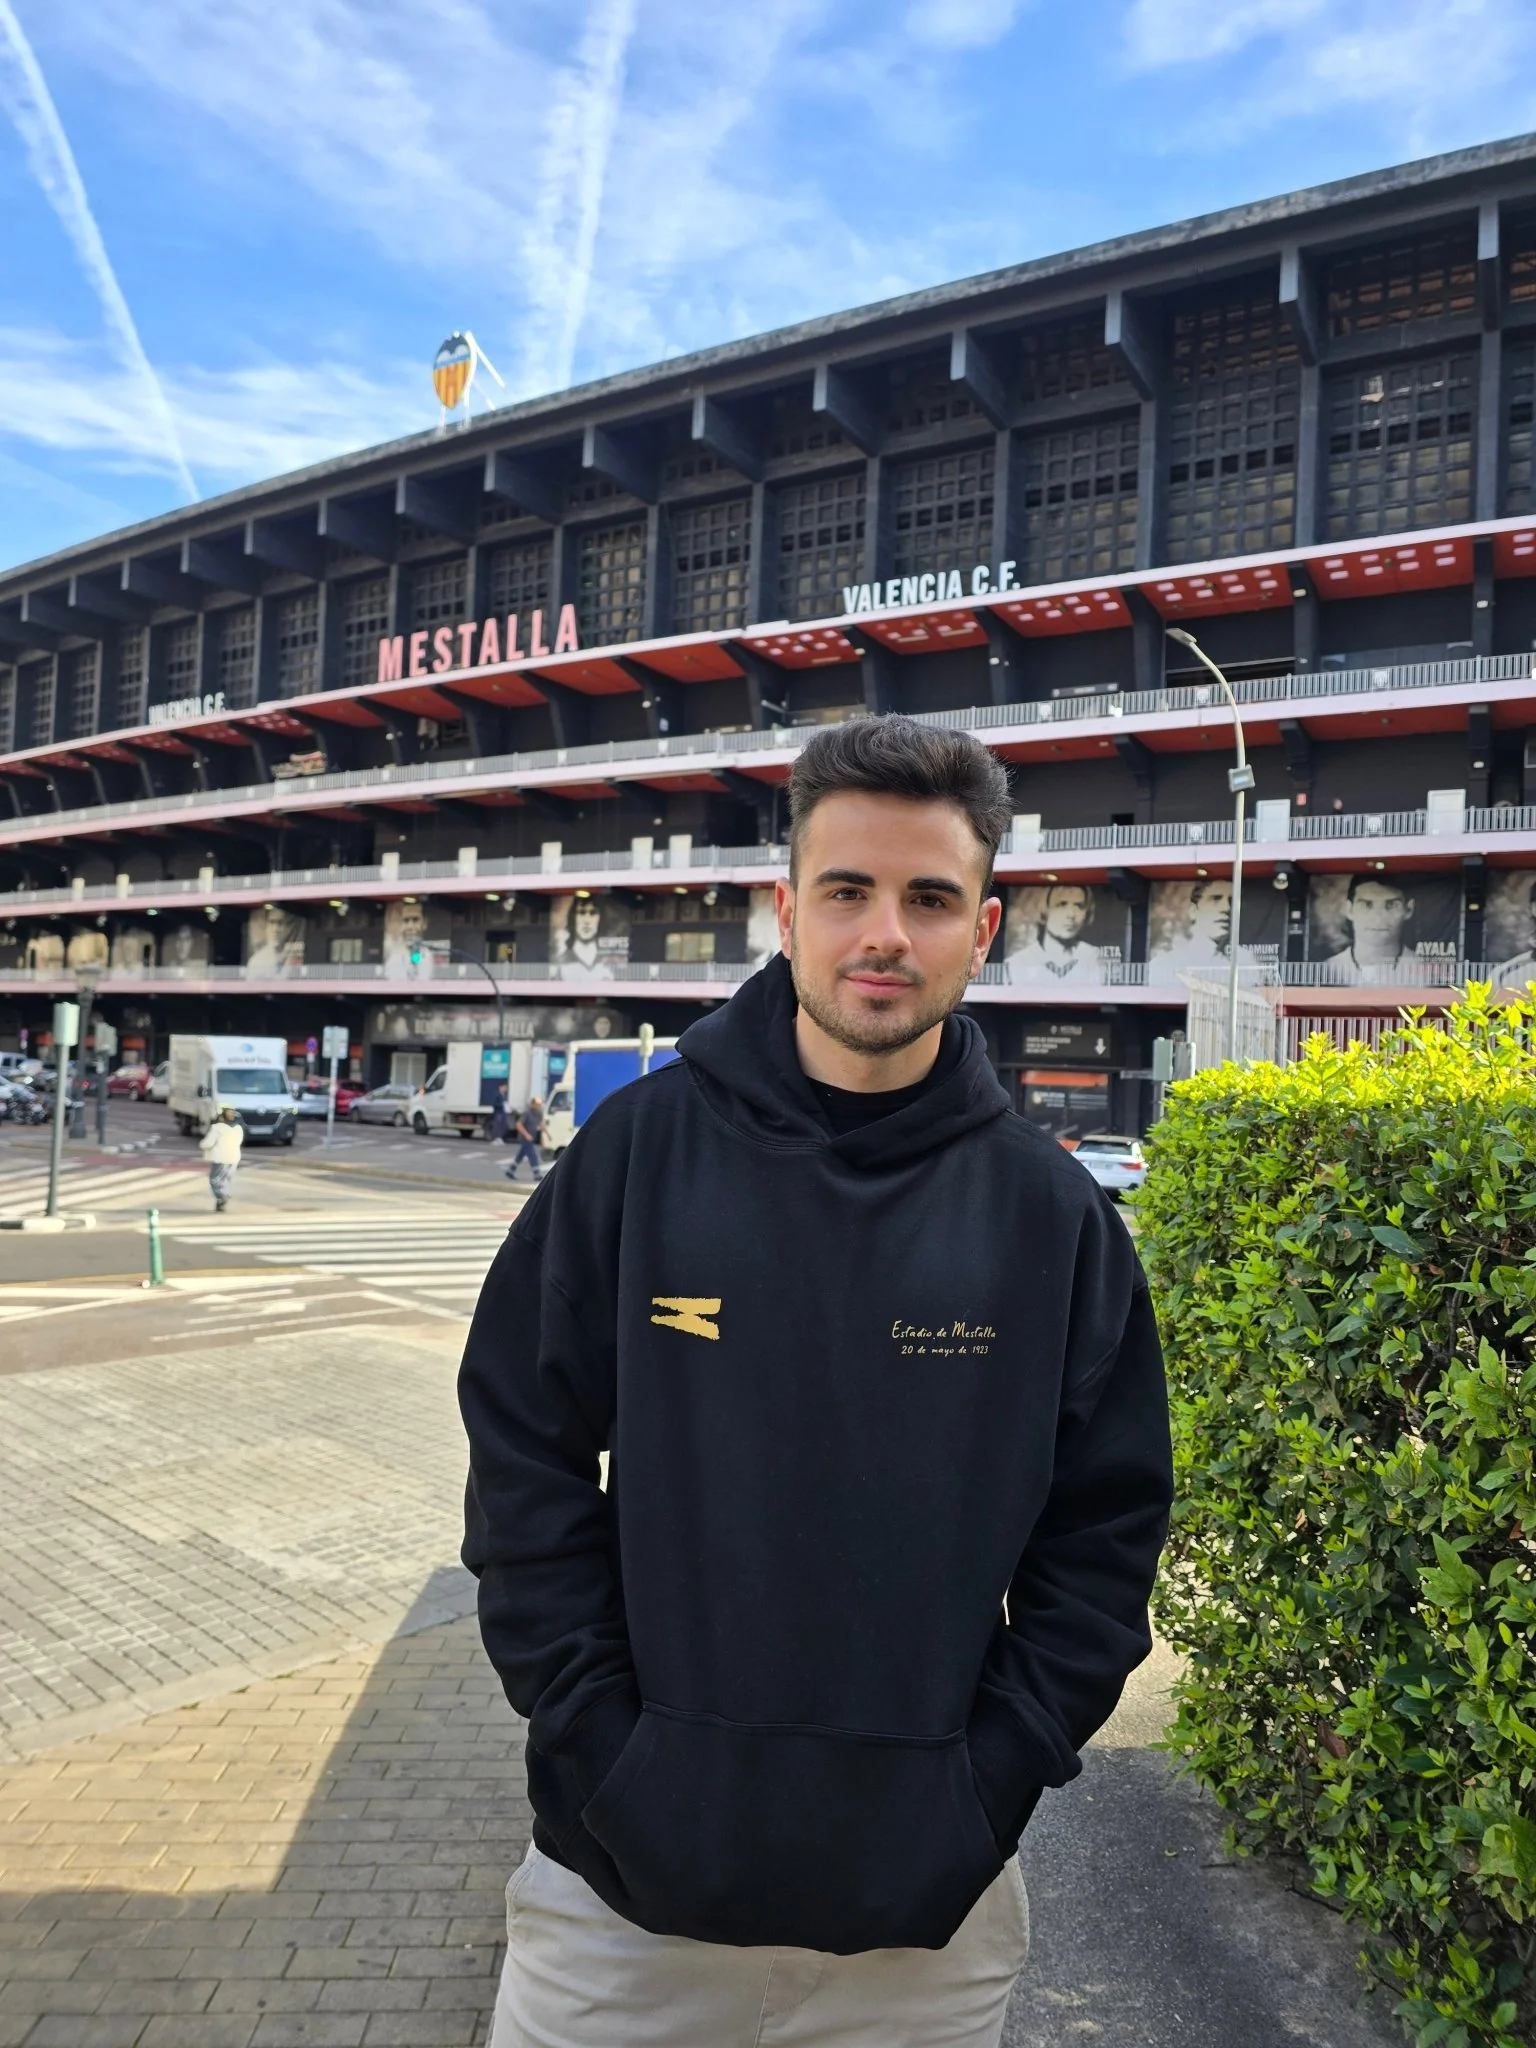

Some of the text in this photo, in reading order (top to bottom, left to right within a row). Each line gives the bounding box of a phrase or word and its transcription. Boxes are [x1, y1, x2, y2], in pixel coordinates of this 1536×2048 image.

[843, 560, 1021, 614] VALENCIA C.F.
[377, 603, 579, 683] MESTALLA
[1415, 941, 1457, 956] AYALA
[892, 1320, 996, 1339] Estadio de Mestalla
[901, 1345, 989, 1358] 20 de mayo de 1923
